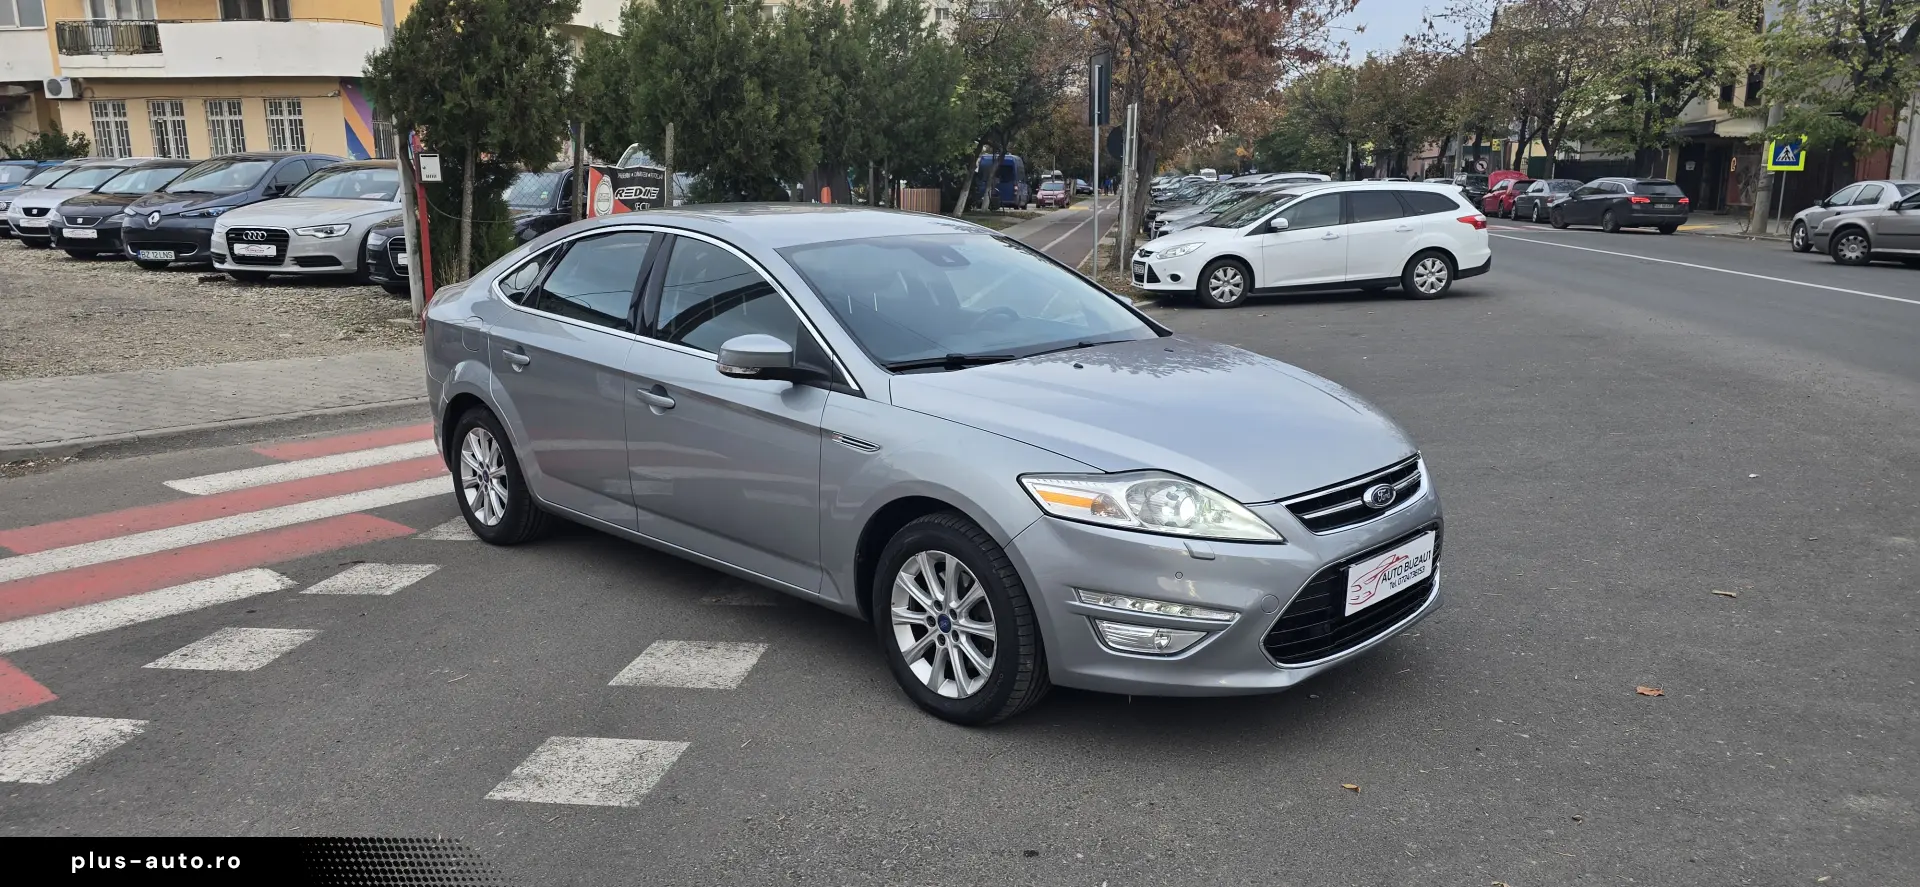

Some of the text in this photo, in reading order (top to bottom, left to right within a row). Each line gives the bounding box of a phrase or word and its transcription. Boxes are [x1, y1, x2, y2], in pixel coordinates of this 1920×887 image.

[141, 251, 173, 259] BZ 12 LNS
[1377, 488, 1391, 502] Ford
[1381, 565, 1403, 585] AUTO
